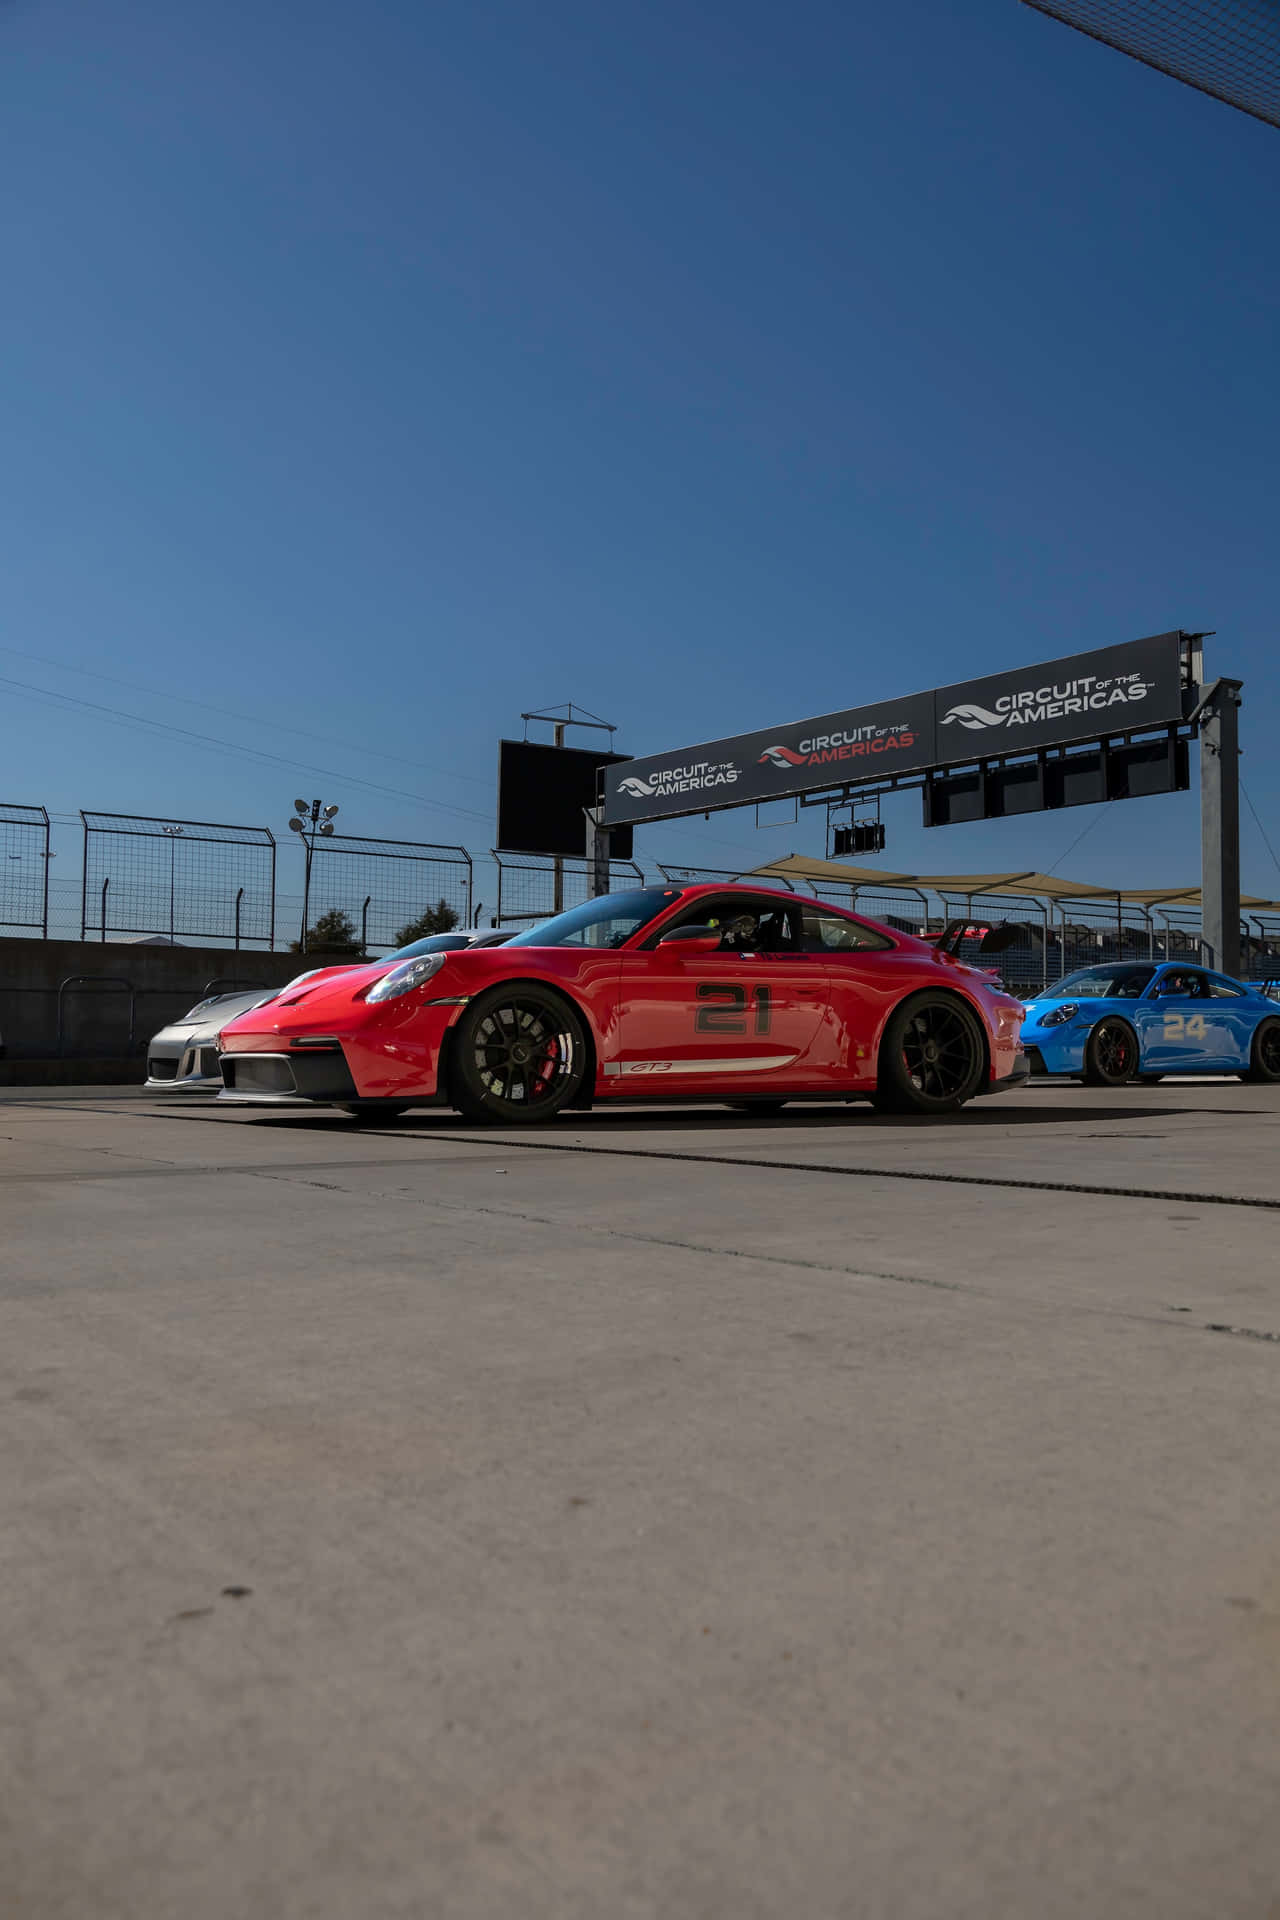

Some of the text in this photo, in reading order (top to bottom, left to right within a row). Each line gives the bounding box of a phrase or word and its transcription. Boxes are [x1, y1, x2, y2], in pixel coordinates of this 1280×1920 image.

[995, 673, 1141, 712] CIRCUIT OF THE
[1006, 683, 1148, 727] AMERICAS
[799, 724, 909, 753] CIRCUIT OF THE
[807, 733, 915, 767] AMERICAS
[649, 762, 709, 785] CIRCUIT
[655, 770, 738, 796] AMERICAS
[694, 981, 772, 1036] 21
[1163, 1013, 1208, 1041] 24
[630, 1062, 673, 1073] GT3
